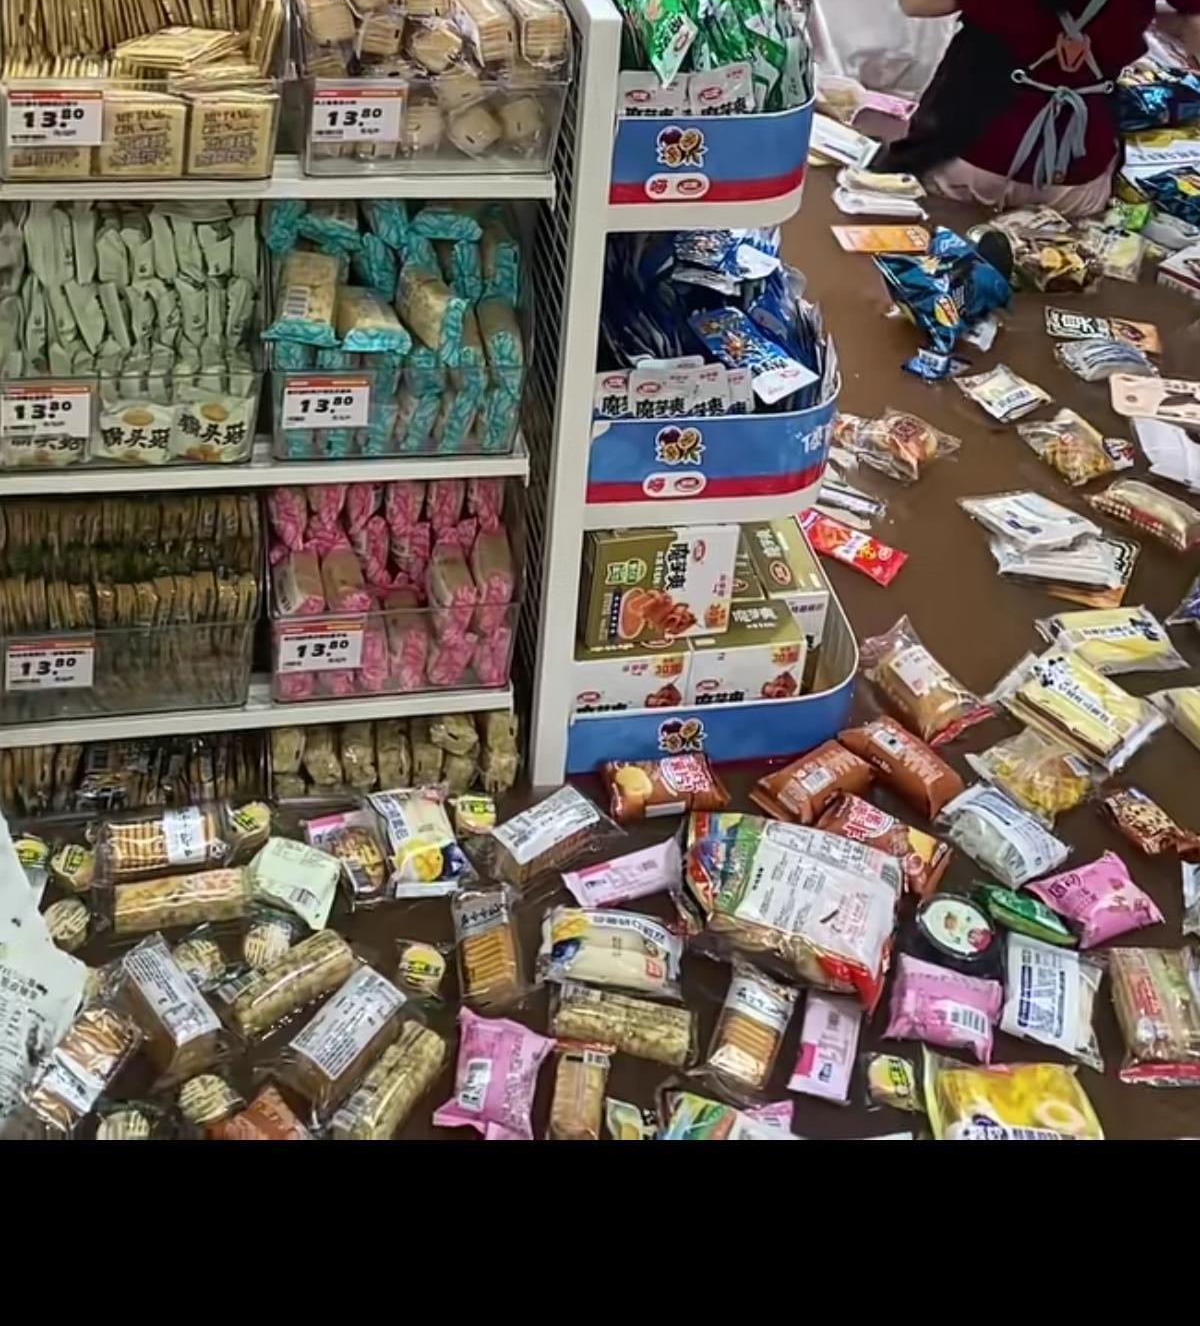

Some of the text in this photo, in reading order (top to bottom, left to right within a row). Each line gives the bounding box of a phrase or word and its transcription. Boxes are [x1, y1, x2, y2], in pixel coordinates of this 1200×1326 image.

[23, 108, 85, 129] 13.80
[327, 107, 383, 127] 13.80
[14, 400, 72, 420] 13.80
[299, 396, 354, 414] 13.80
[295, 639, 350, 659] 13.80
[20, 657, 77, 676] 13.80
